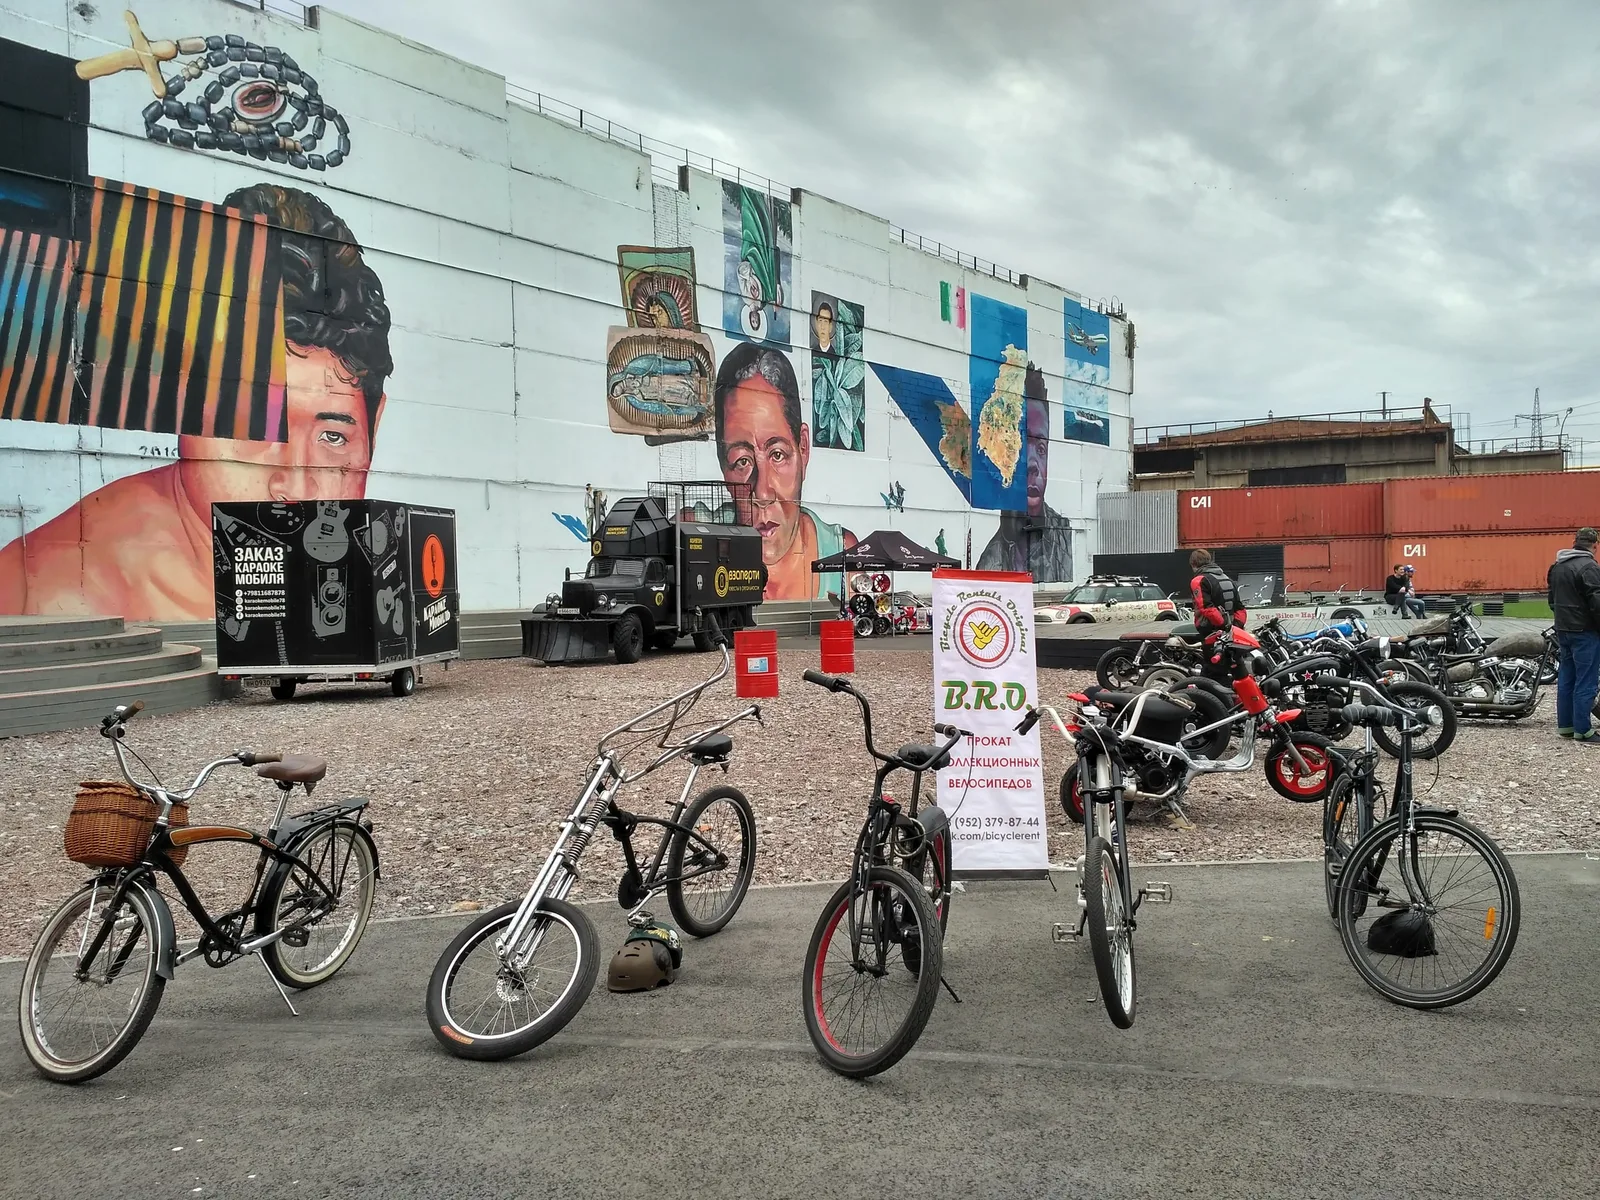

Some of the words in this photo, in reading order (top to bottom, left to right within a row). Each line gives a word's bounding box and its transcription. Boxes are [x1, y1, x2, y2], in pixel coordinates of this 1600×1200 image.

[1190, 496, 1211, 508] CAI
[234, 547, 284, 562] ЗАКАЗ
[1403, 544, 1426, 557] CAI
[235, 562, 284, 573] КАРАОКЕ
[235, 573, 284, 585] МОБИЛЯ
[1300, 611, 1327, 620] Hapy
[940, 604, 958, 652] Bicycle
[956, 589, 1002, 603] Rentals
[1006, 599, 1028, 654] Original
[1288, 672, 1299, 682] K
[941, 681, 1032, 711] B.R.O.
[967, 737, 1012, 746] ПРОКАТ
[948, 758, 1040, 768] ОЛЛЕКЦИОННЫХ
[949, 779, 1033, 789] ВЕЛОСИПЕДОВ
[955, 817, 982, 829] (952)
[985, 817, 1040, 827] 379-87-44
[951, 831, 1041, 842] k.com/bicyclerent
